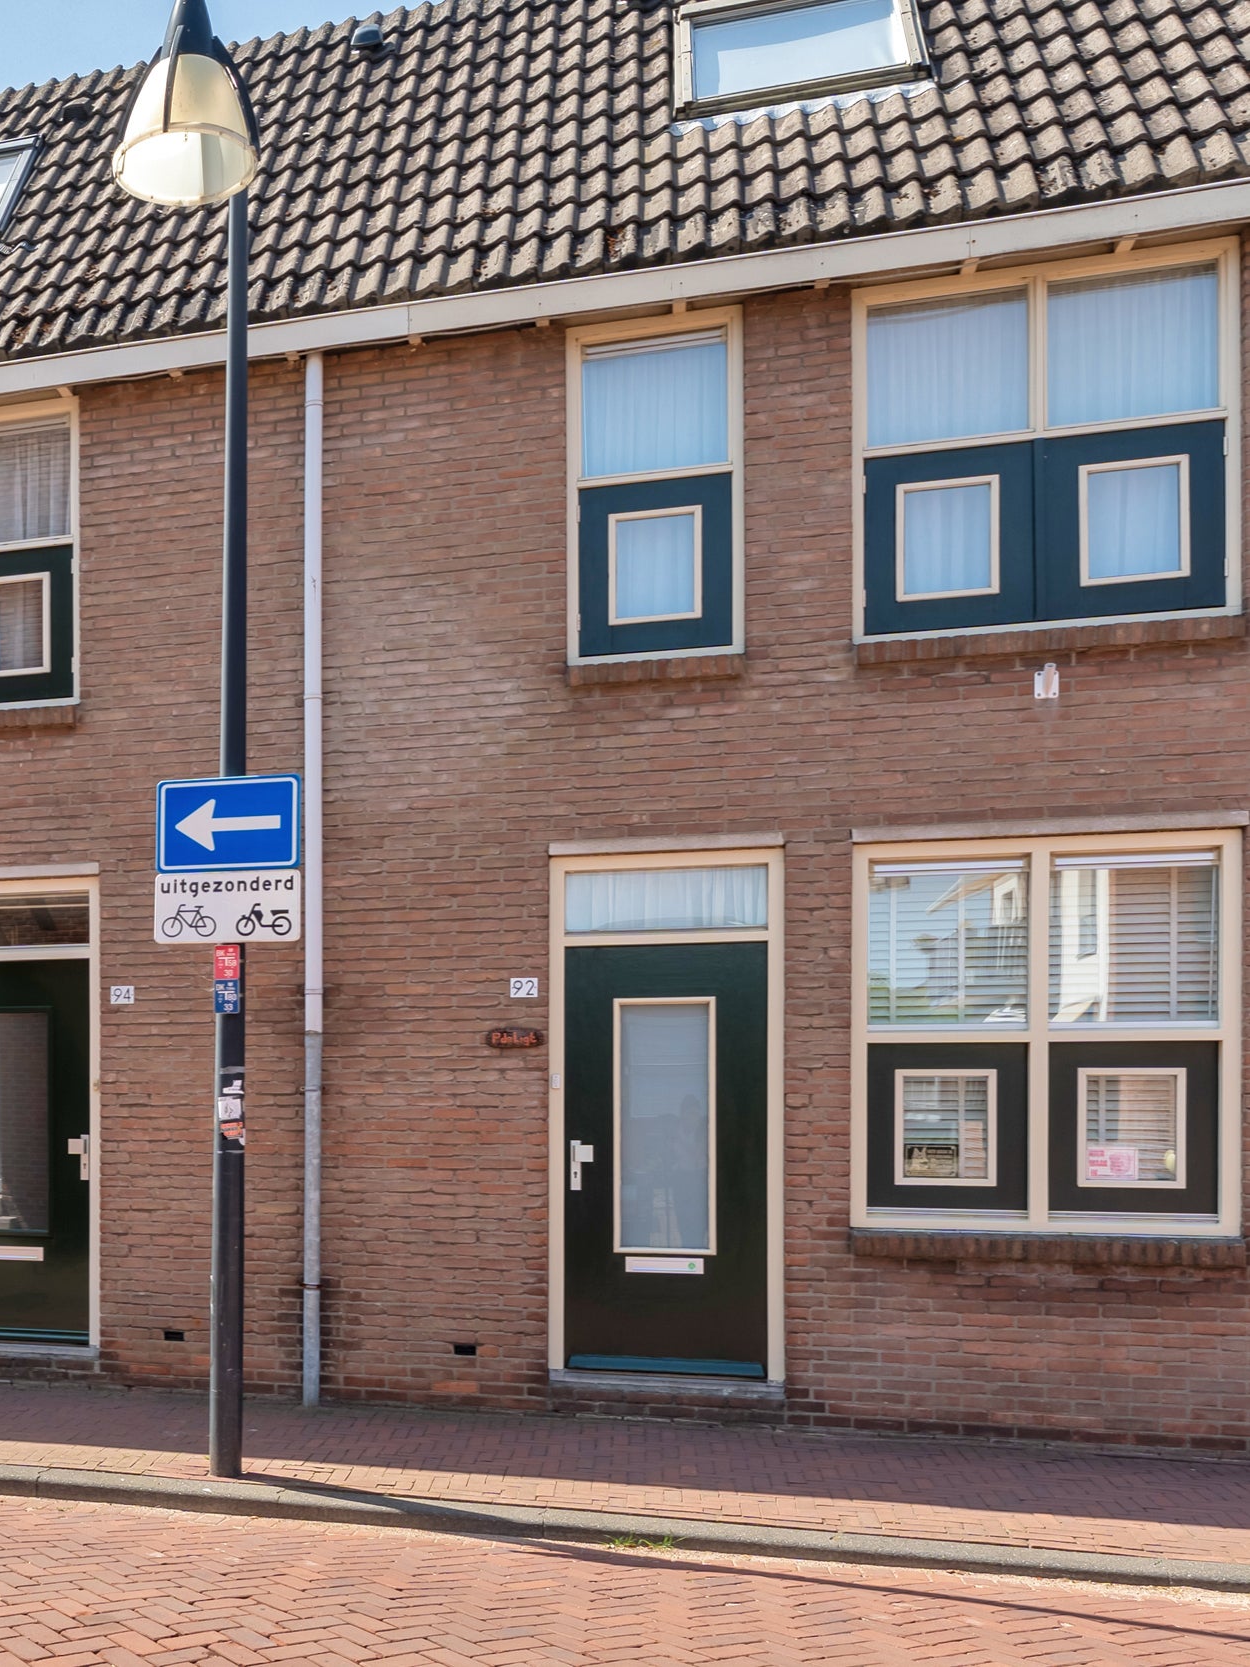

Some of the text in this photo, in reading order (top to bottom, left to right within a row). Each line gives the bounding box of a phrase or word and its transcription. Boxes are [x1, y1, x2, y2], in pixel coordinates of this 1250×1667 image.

[161, 875, 294, 898] uitgezonderd
[113, 987, 132, 1003] 94
[512, 980, 535, 996] 92
